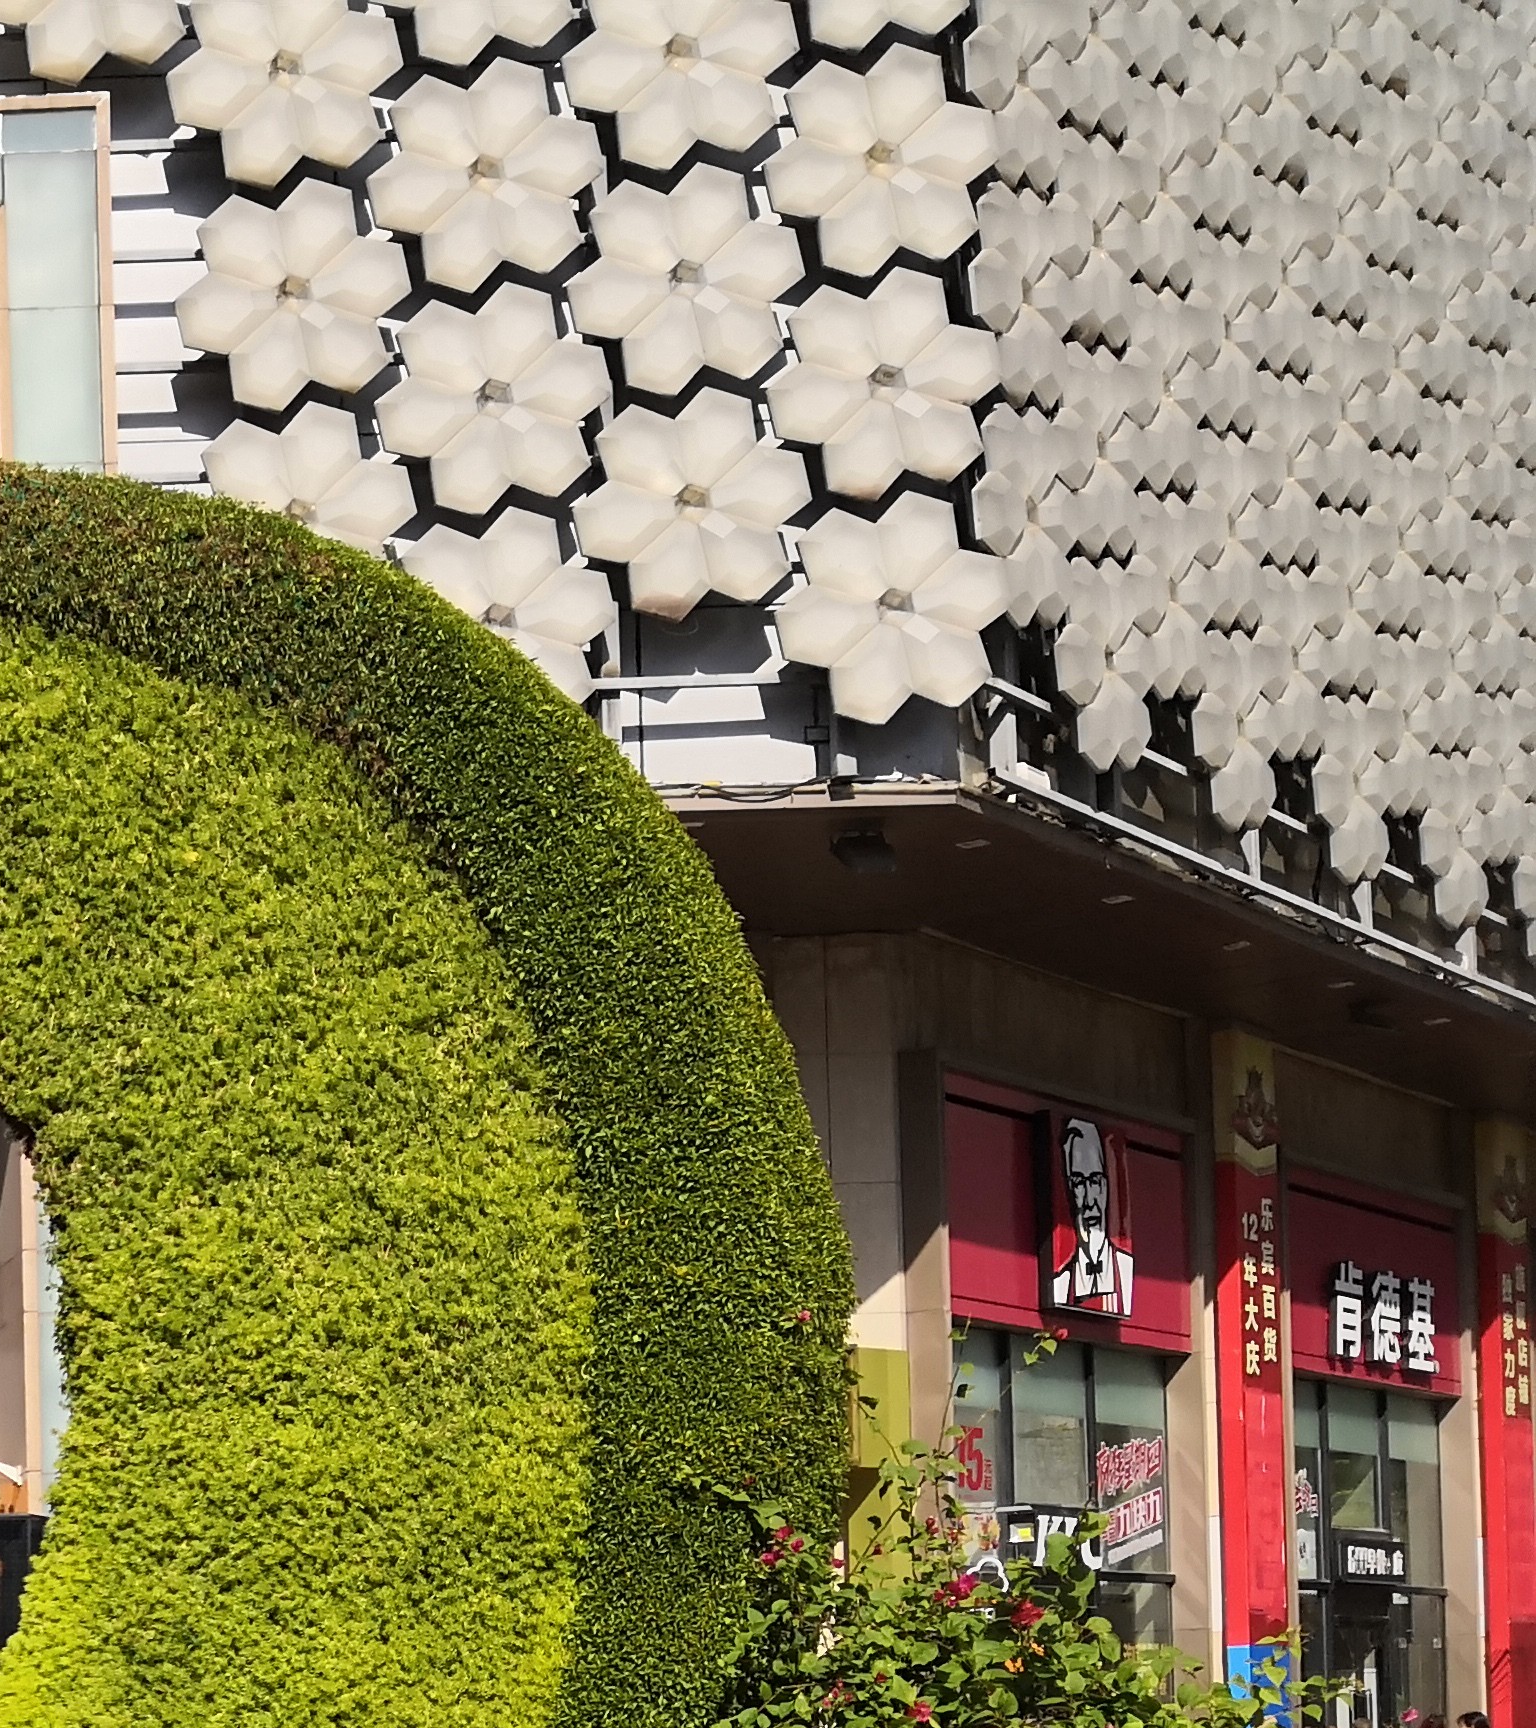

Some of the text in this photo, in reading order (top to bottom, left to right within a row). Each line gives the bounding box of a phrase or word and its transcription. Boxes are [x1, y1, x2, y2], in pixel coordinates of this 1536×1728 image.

[1241, 1211, 1261, 1377] 12年大庆
[1260, 1197, 1278, 1363] 乐宾百货
[1334, 1260, 1436, 1374] 肯德基
